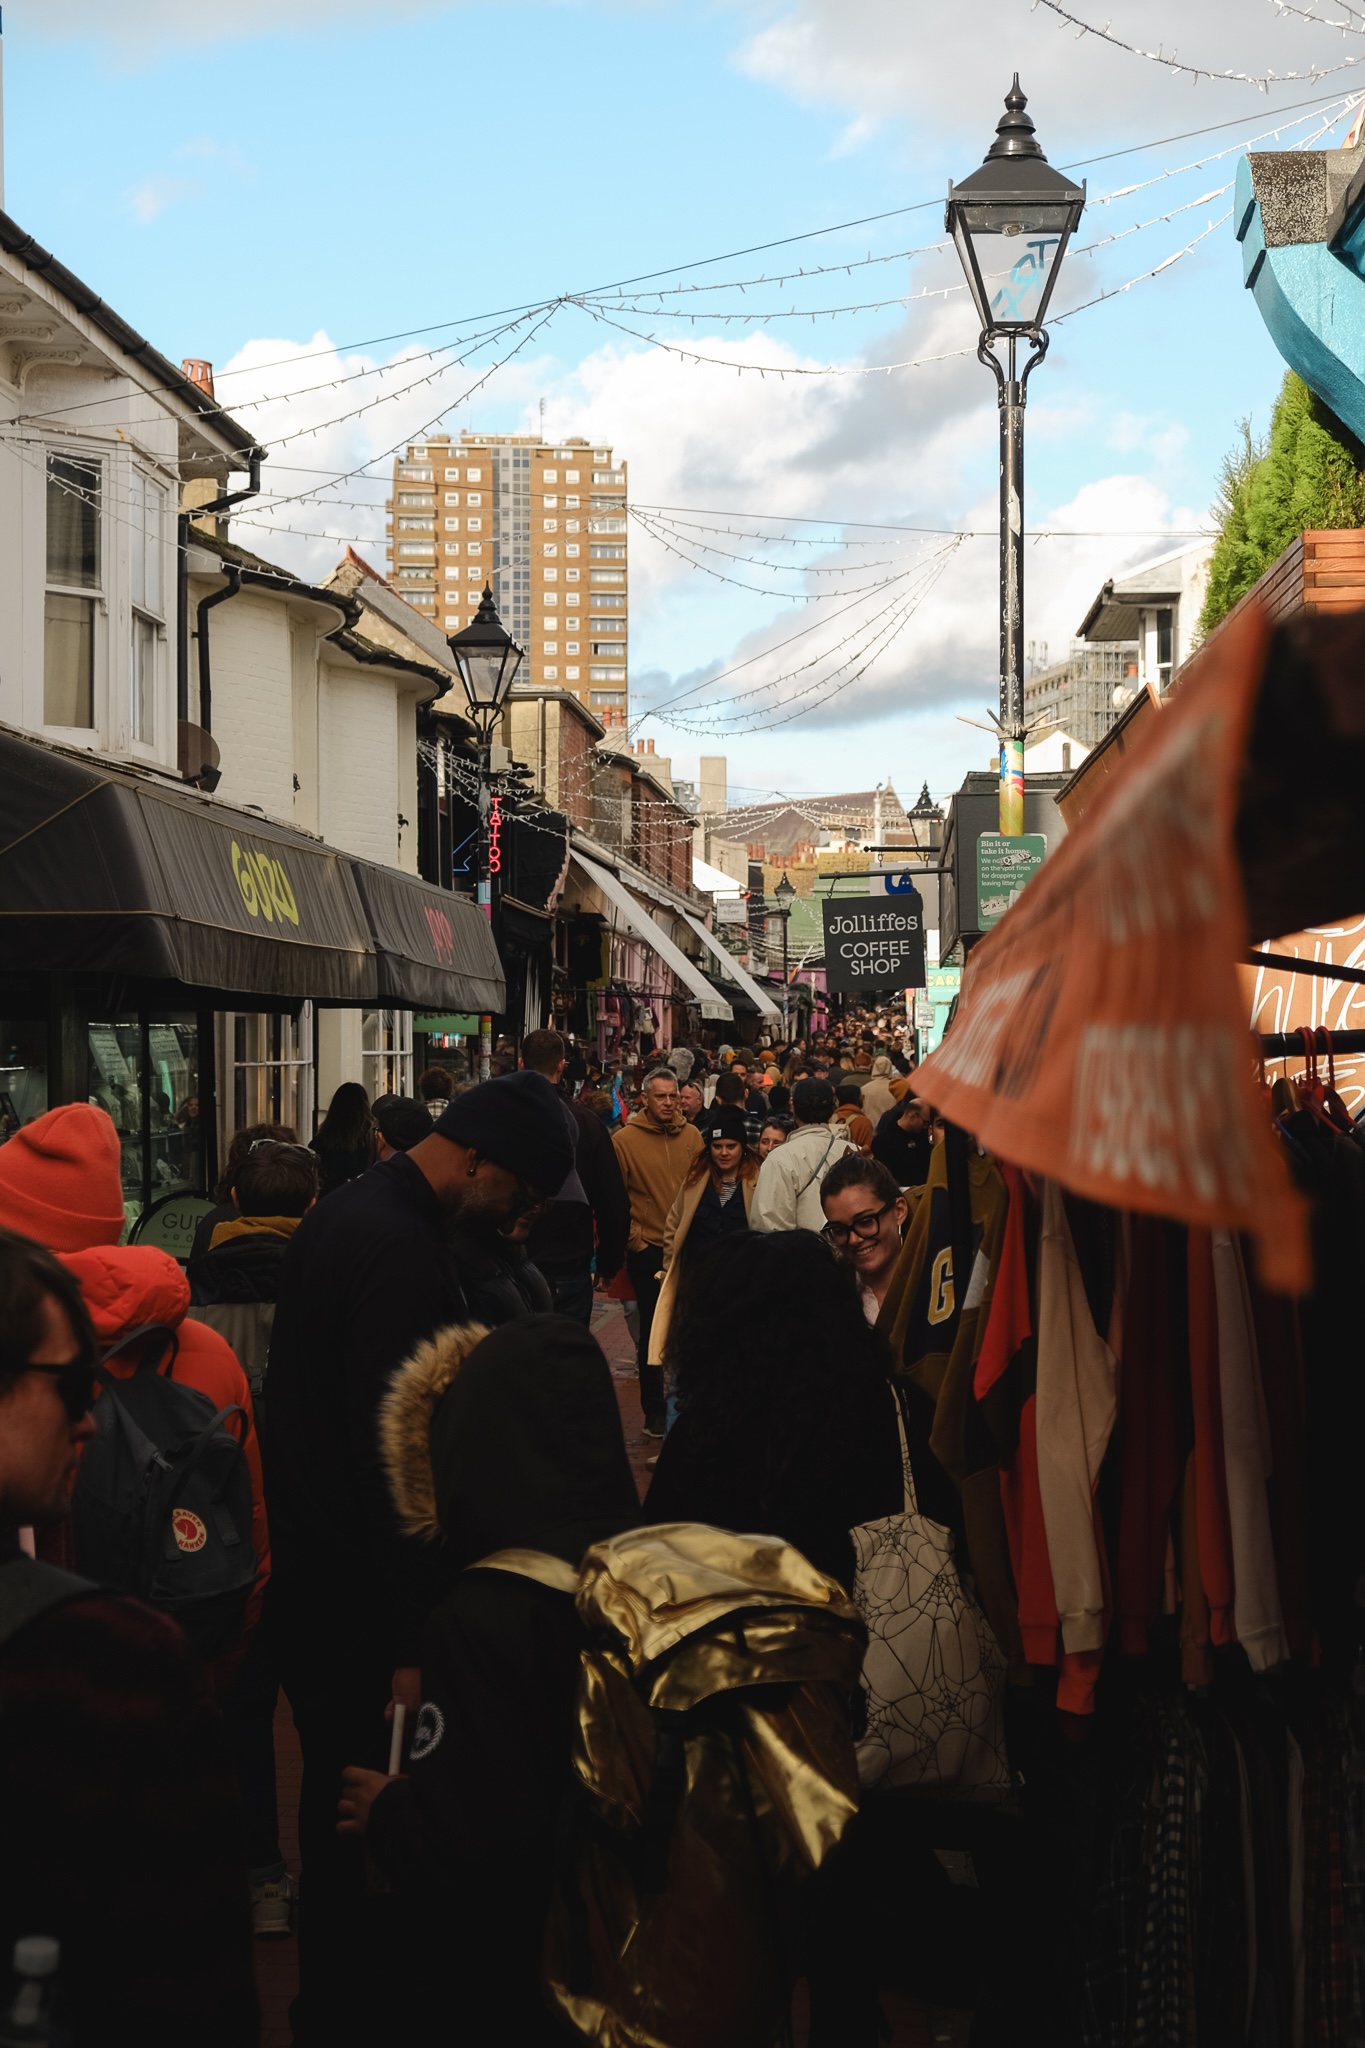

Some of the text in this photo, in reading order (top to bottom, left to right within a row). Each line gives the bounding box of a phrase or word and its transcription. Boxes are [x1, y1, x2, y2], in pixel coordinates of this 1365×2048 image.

[490, 797, 503, 872] TATTOO
[231, 840, 299, 926] GURU
[981, 880, 1001, 888] leaving
[829, 913, 918, 935] Jolliffes
[840, 940, 910, 959] COFFEE
[850, 958, 901, 976] SHOP
